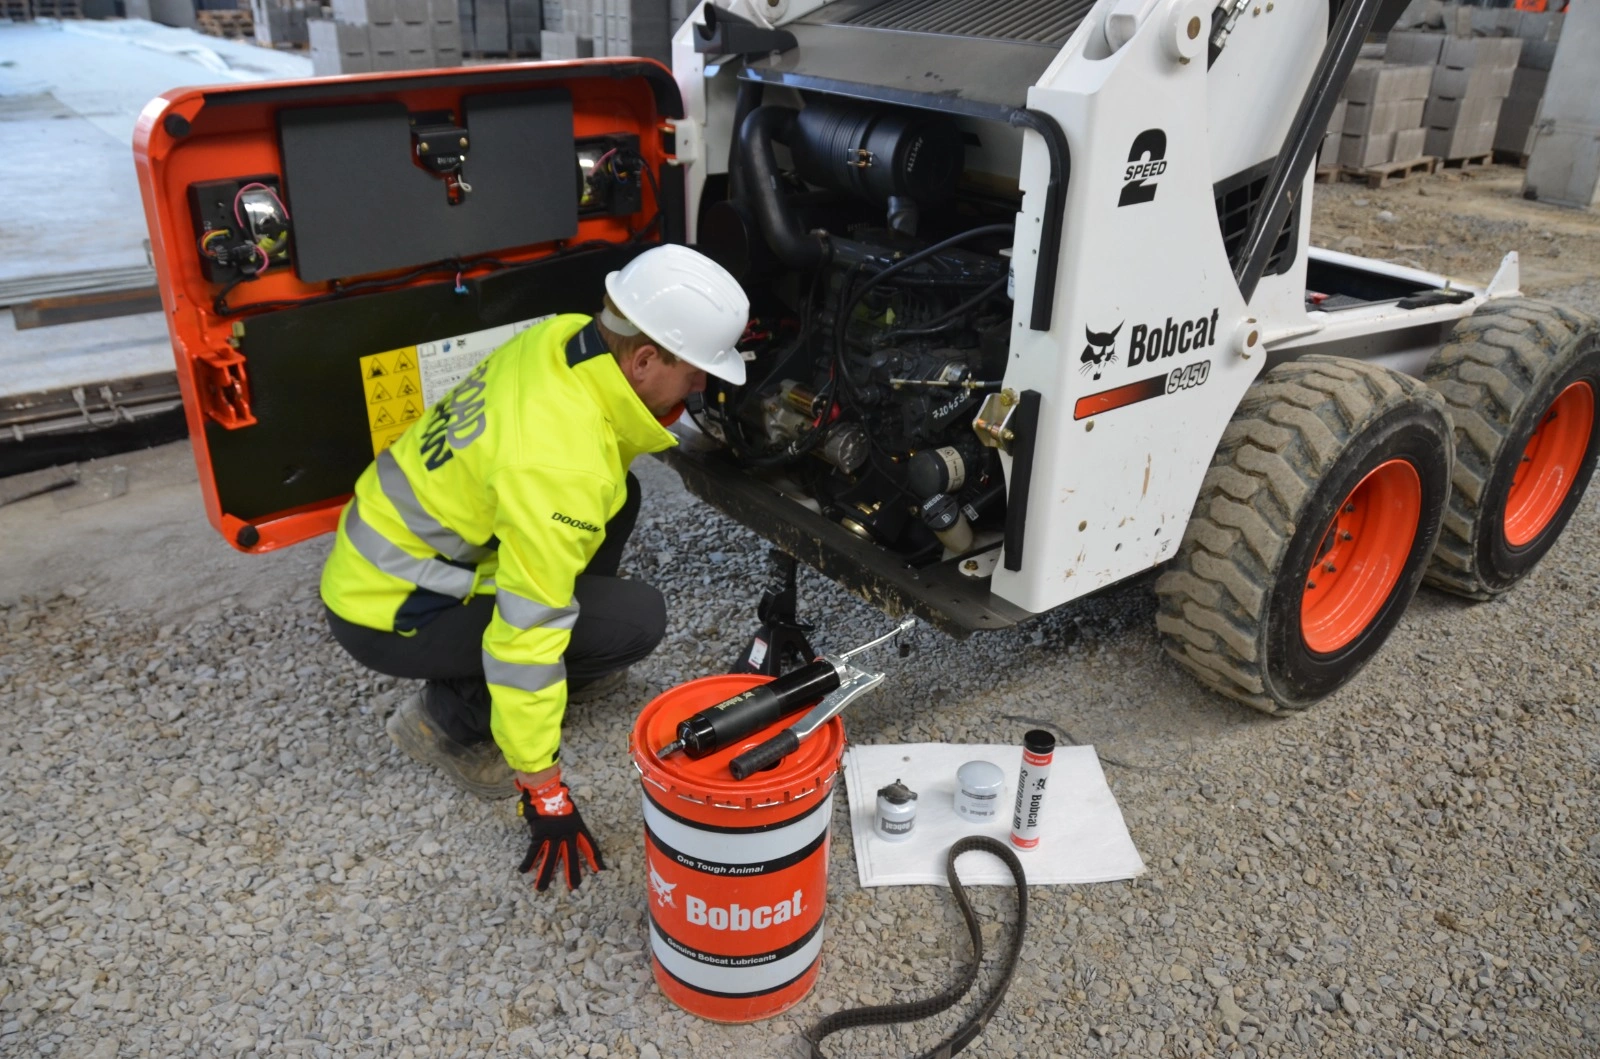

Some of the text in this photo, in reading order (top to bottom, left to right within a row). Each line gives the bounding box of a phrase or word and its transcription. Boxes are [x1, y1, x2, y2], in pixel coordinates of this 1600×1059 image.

[1124, 161, 1167, 181] SPEED
[1127, 307, 1219, 368] Bobcat
[1167, 359, 1211, 394] S450
[923, 493, 944, 511] DIESEL
[551, 511, 601, 532] DOOSAN
[1027, 794, 1042, 828] Bobcat
[677, 855, 764, 874] One Tough Animal
[686, 889, 803, 931] Bobcat
[667, 937, 776, 965] Genuine Bobcat Lubricants
